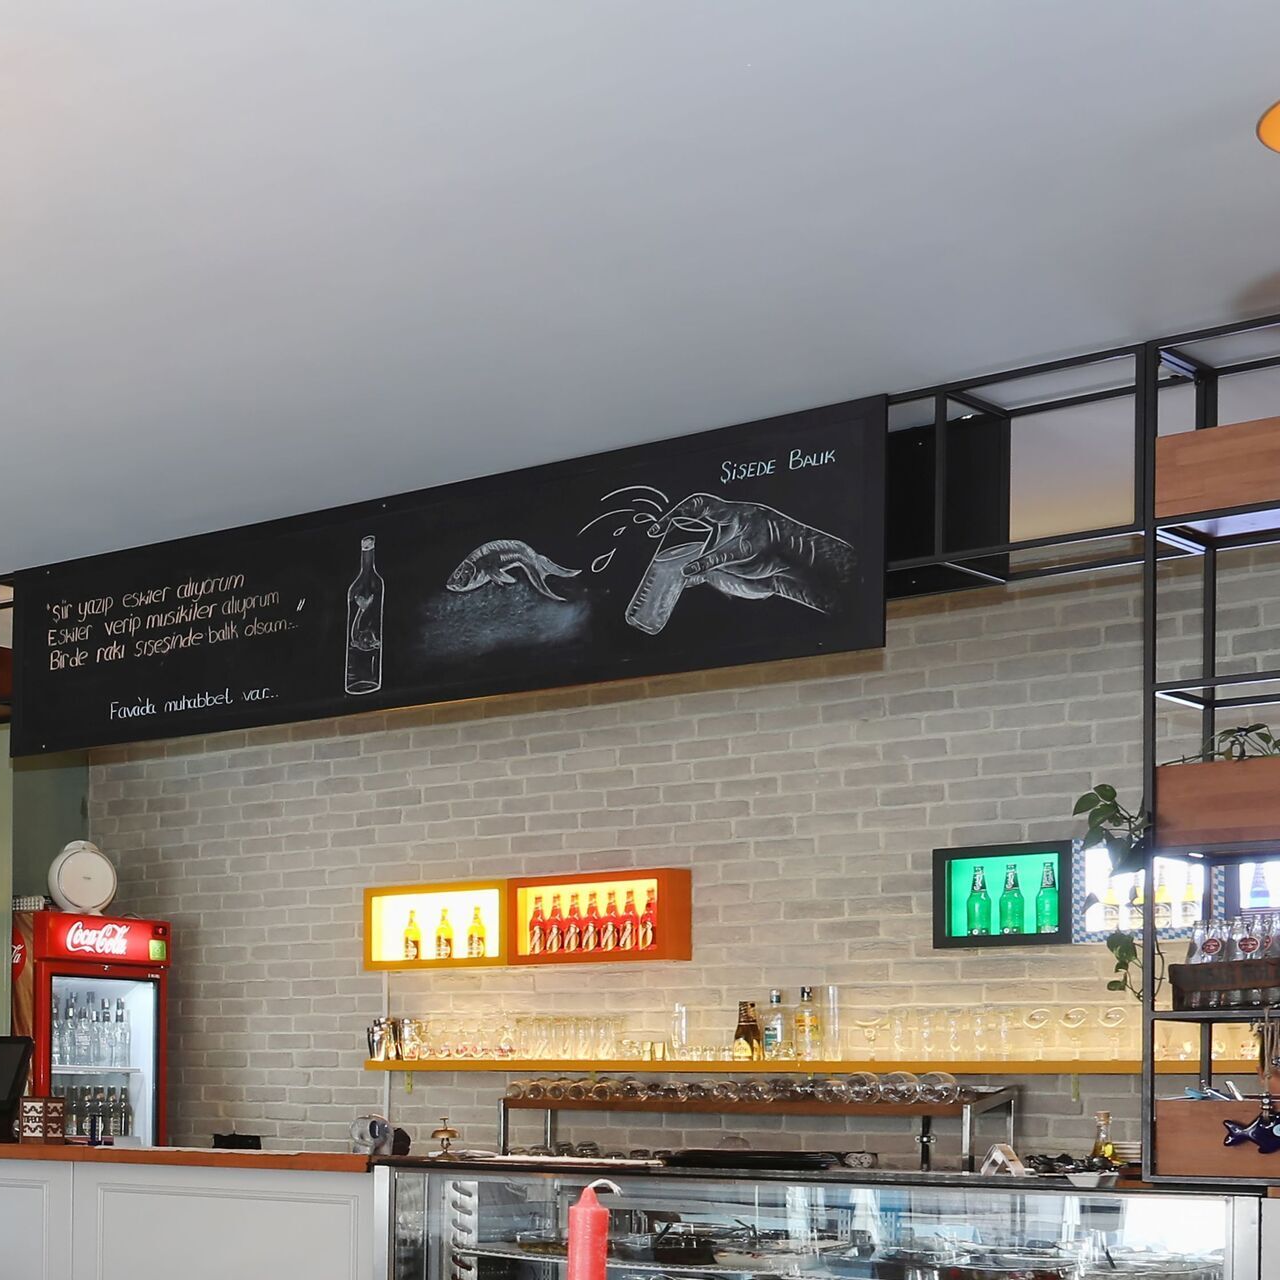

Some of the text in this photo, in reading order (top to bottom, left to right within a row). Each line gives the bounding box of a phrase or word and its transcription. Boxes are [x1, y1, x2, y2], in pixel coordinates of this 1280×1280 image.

[788, 448, 836, 470] BALIK
[47, 591, 279, 646] Eskiler verip musikiler alıyorum
[78, 596, 114, 622] yazıp
[122, 586, 171, 608] eskiler
[176, 573, 245, 602] alıyorum
[96, 640, 125, 663] rakı
[208, 620, 239, 644] balık
[66, 921, 130, 955] Coca-Cola
